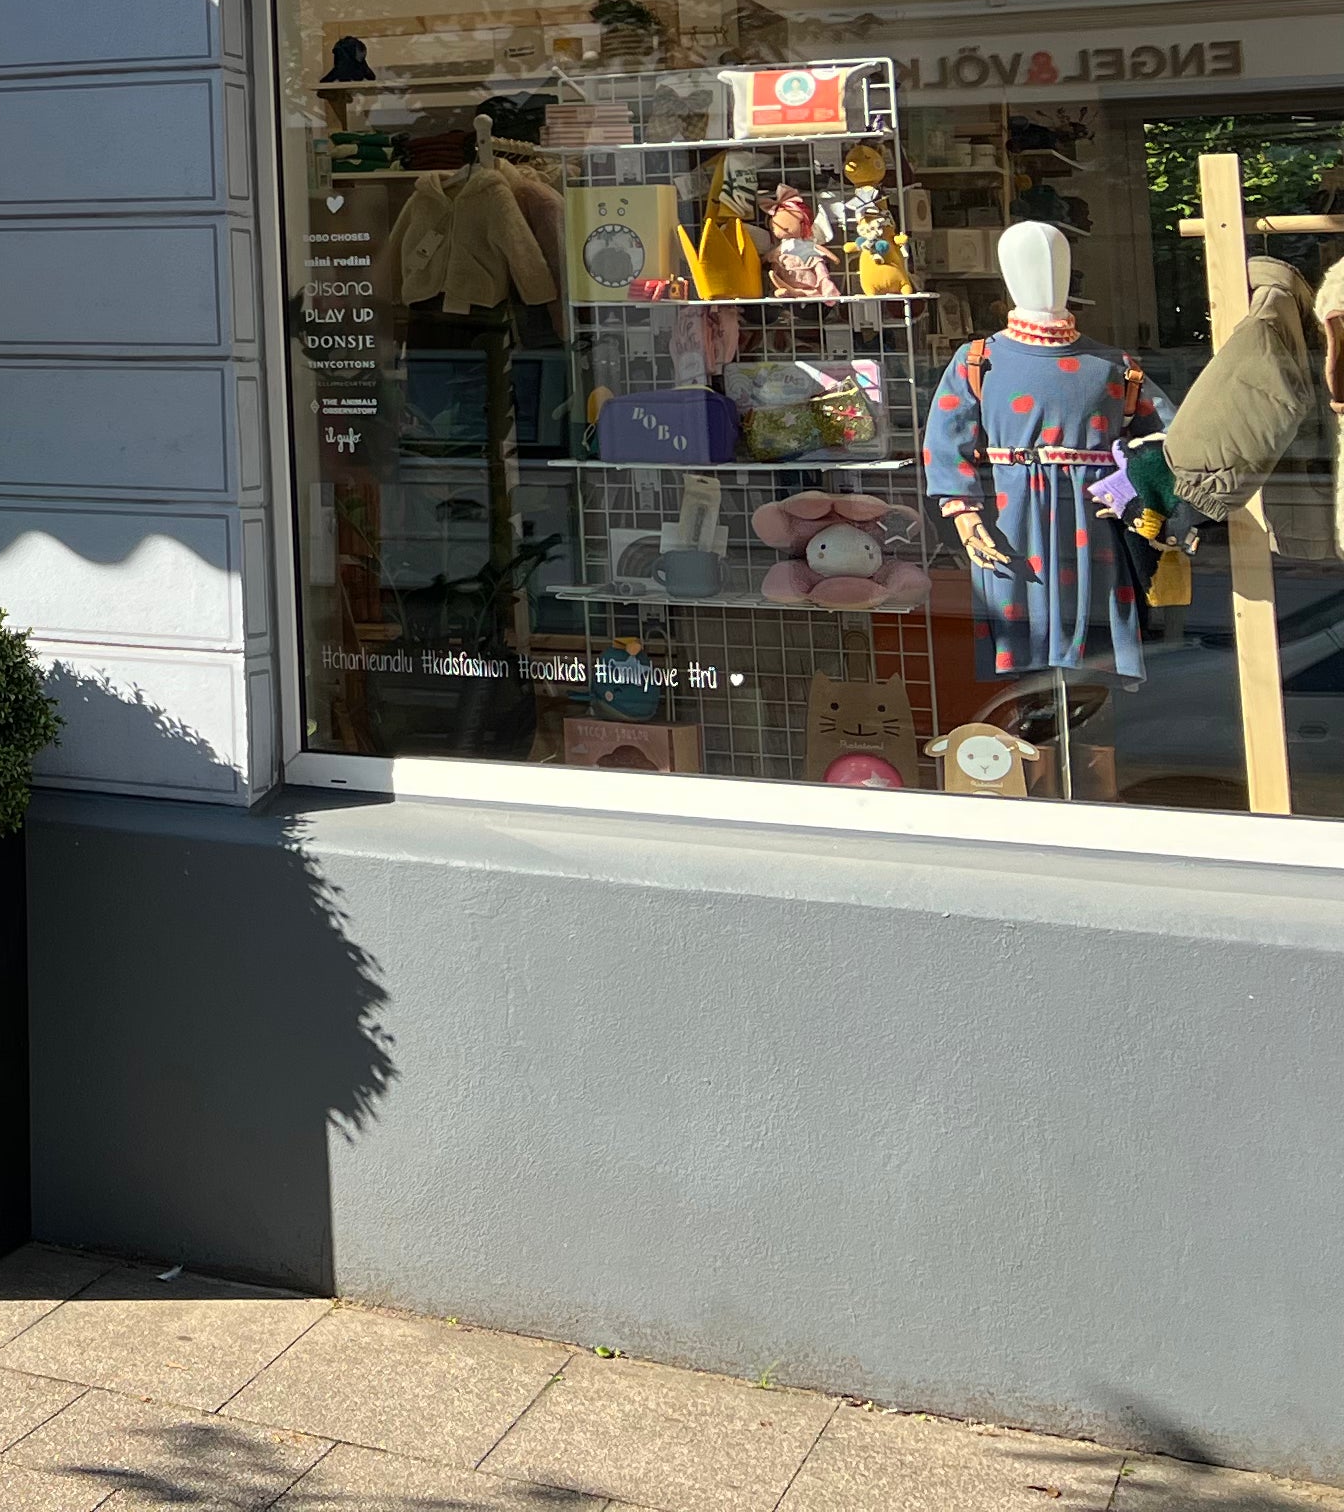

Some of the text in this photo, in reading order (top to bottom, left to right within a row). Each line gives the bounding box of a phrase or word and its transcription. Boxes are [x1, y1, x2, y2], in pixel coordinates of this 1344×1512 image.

[302, 232, 370, 242] BOBO CHOSES
[304, 255, 371, 266] mini rodini
[305, 280, 372, 296] disana
[305, 308, 374, 323] PLAY UP
[308, 334, 375, 350] DONSJE
[307, 360, 375, 369] TINYCOTTONS
[322, 398, 378, 406] THE ANIMALS
[632, 406, 688, 452] BOBO
[322, 644, 718, 693] #charlieundlu #kidsfashion #coolkids #familylove #rü
